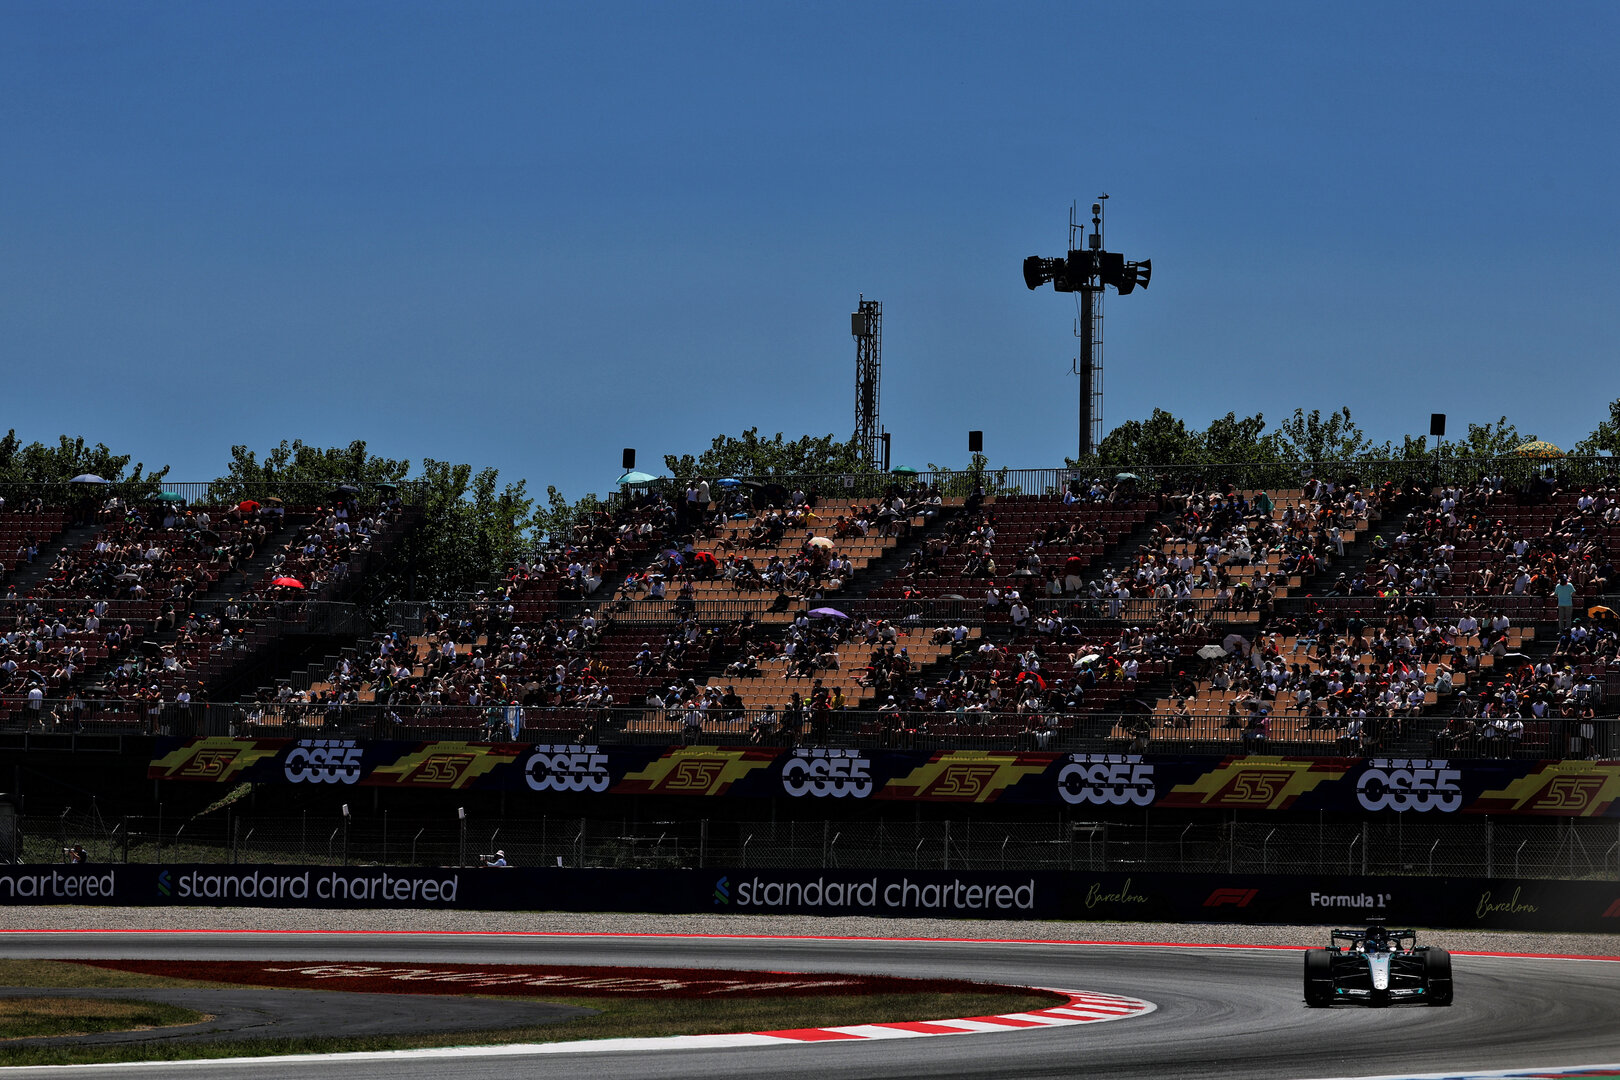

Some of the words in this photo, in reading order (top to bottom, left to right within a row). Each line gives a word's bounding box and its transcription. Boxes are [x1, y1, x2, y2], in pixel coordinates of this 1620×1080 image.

[535, 744, 601, 754] GRADA
[792, 749, 862, 758] GRADA
[1068, 753, 1145, 764] GRADA
[180, 751, 237, 776] 55
[412, 756, 472, 783] 55
[665, 762, 724, 789] 55
[1368, 758, 1452, 769] GRADA
[931, 767, 996, 796] 55
[1220, 773, 1290, 803] 55
[1532, 778, 1603, 809] 55
[178, 870, 310, 898] standard
[316, 872, 458, 901] chartered
[736, 877, 877, 906] standard
[884, 878, 1034, 909] chartered
[1085, 877, 1149, 909] Barcelona
[1310, 892, 1374, 907] Formula
[1475, 886, 1538, 918] Barcelona
